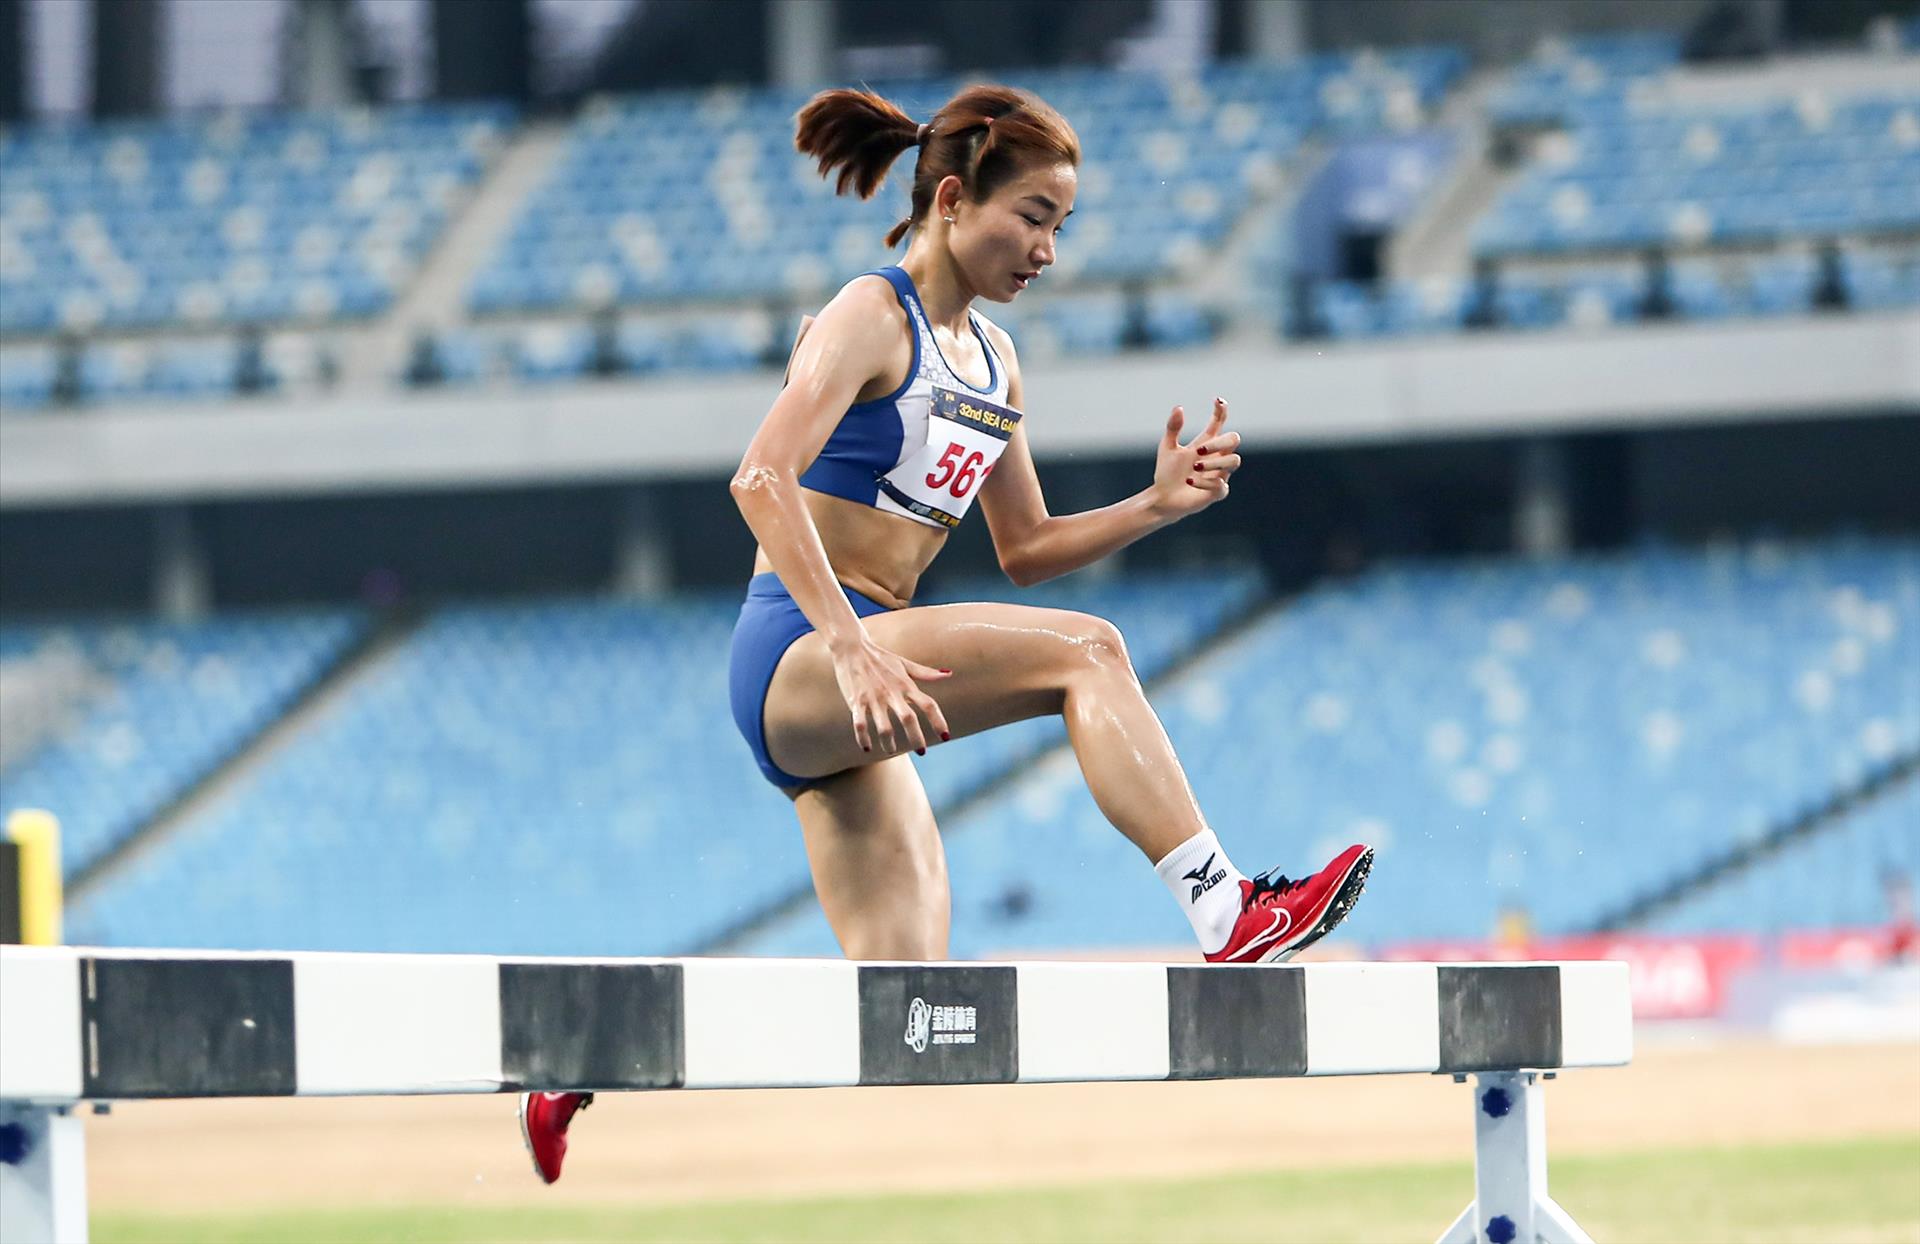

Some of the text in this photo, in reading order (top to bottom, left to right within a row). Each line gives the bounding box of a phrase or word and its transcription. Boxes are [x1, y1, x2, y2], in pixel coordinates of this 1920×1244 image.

[959, 402, 983, 421] 32nd
[982, 410, 1001, 428] SEA
[1191, 868, 1227, 904] MIZUNO
